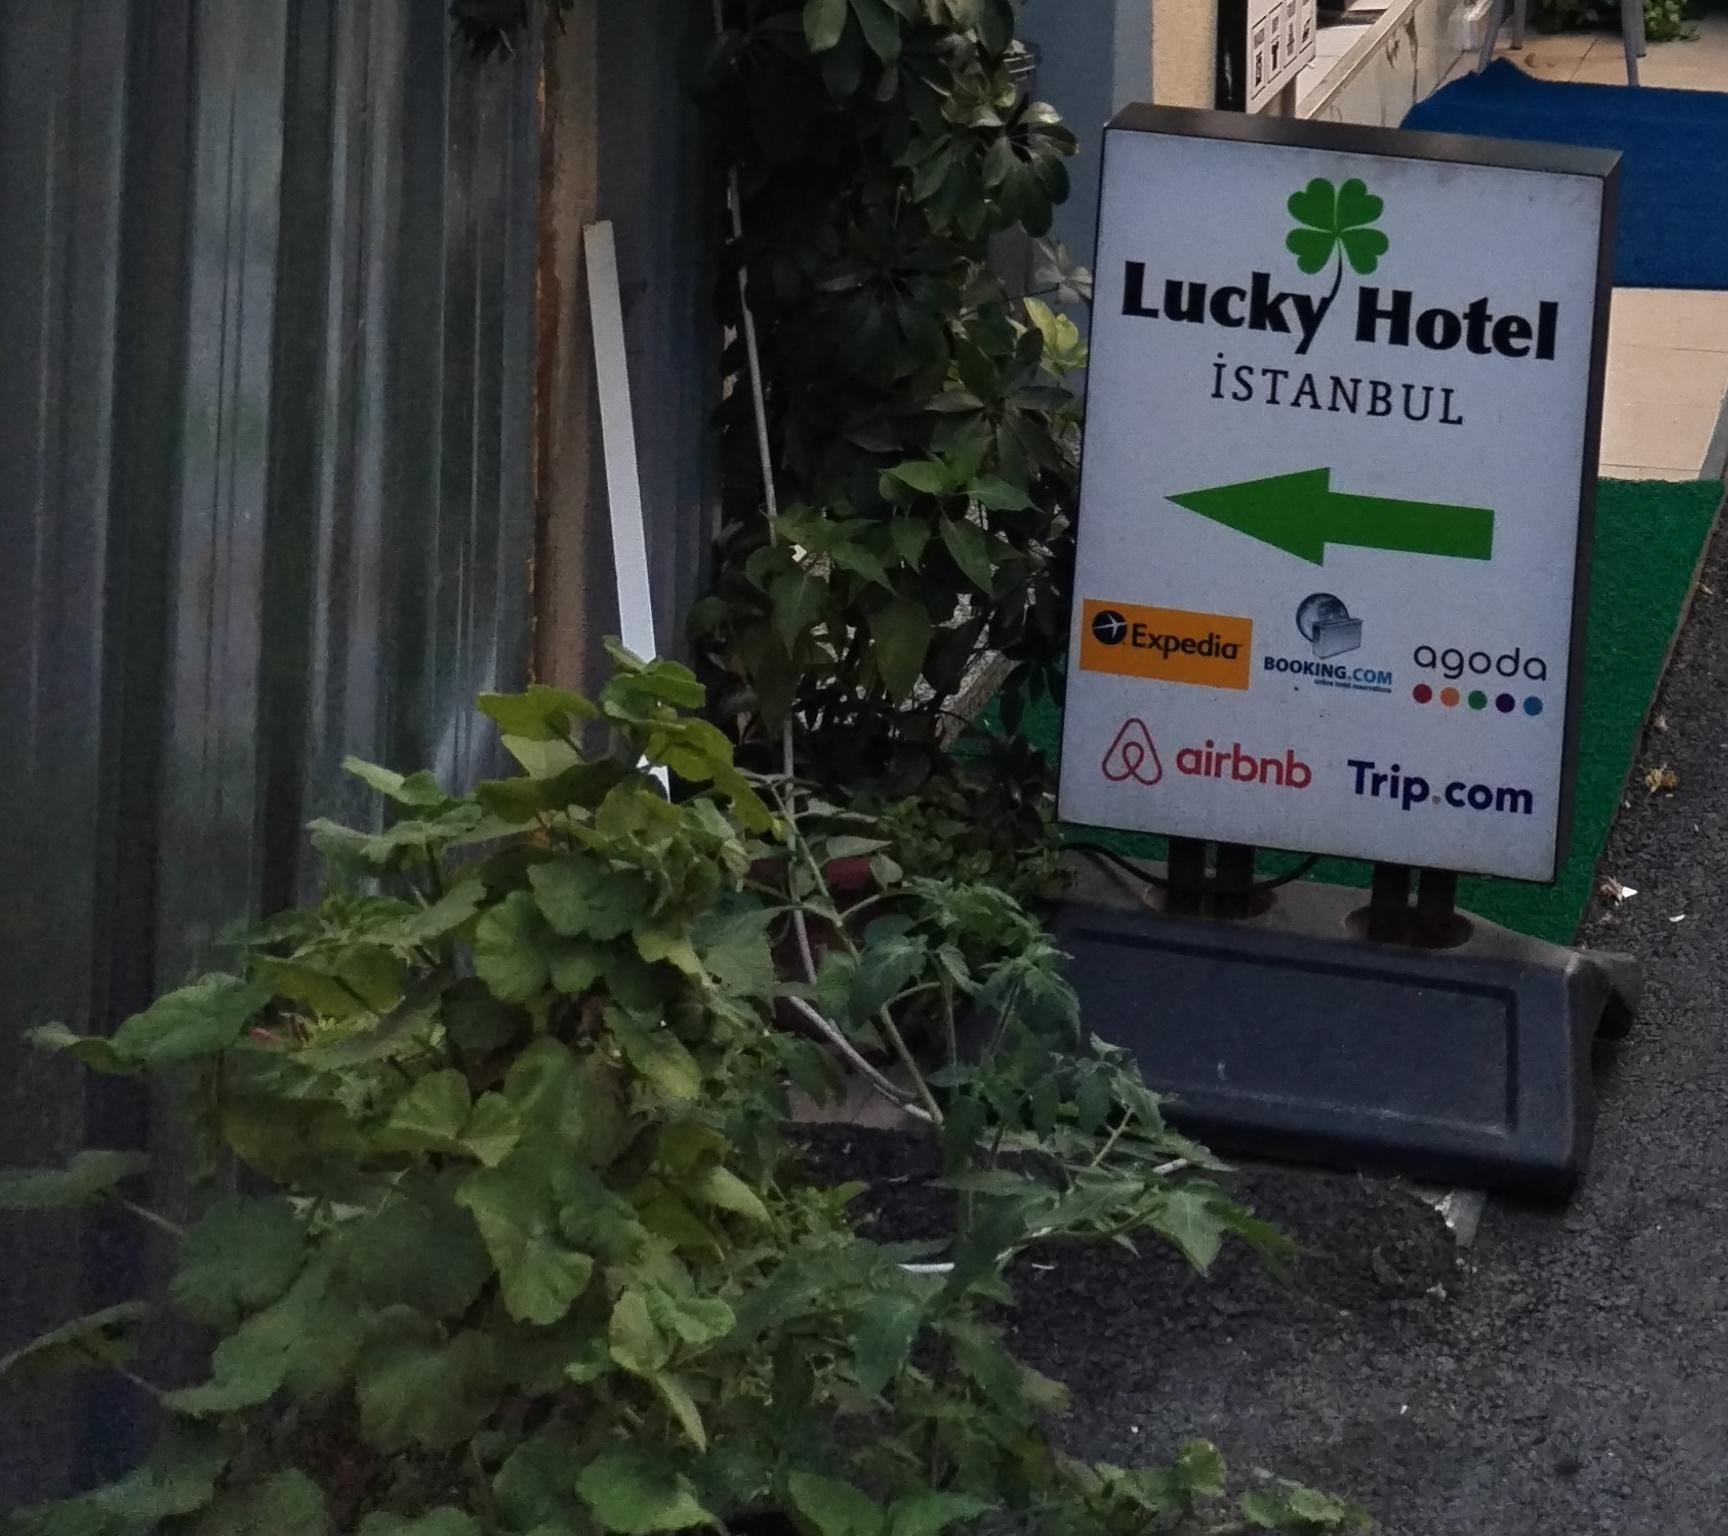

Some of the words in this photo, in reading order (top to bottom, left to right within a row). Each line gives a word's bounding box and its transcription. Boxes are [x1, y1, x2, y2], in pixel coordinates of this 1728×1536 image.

[1121, 260, 1336, 355] Lucky
[1354, 287, 1559, 361] Hotel
[1210, 352, 1464, 426] İSTANBUL
[1131, 622, 1242, 664] Expedia
[1414, 642, 1548, 683] agoda
[1263, 655, 1393, 686] BOOKING.COM
[1175, 739, 1313, 790] airbnb
[1347, 760, 1535, 816] Trip.com
